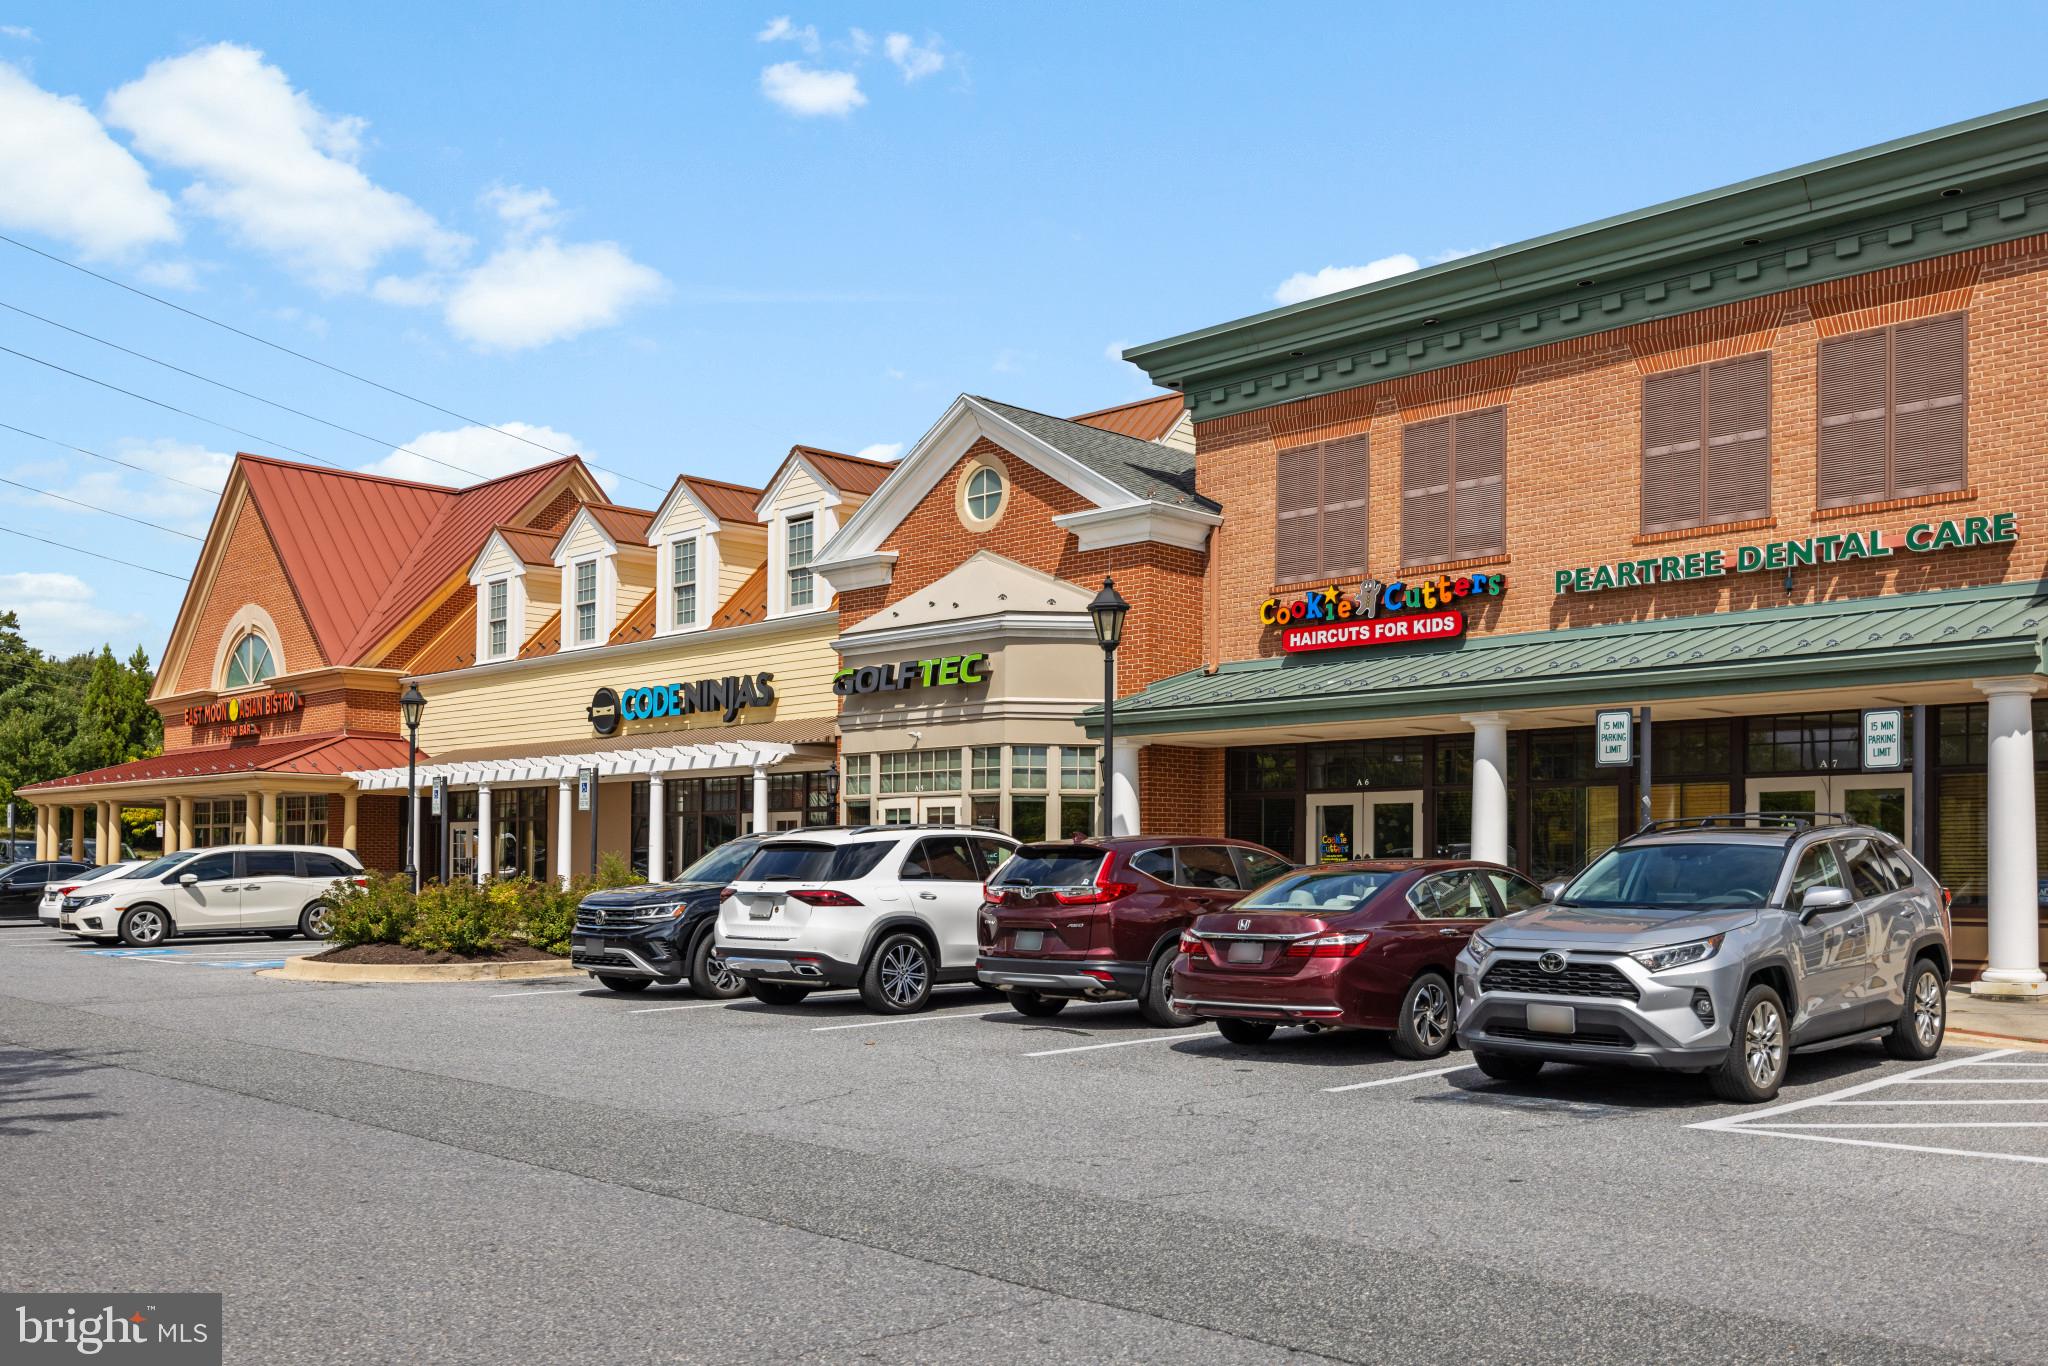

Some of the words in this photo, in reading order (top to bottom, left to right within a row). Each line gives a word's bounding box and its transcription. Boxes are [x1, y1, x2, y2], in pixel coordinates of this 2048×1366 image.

[1555, 550, 1725, 594] PEARTREE
[1736, 530, 1893, 573] DENTAL
[1905, 513, 2018, 552] CARE
[1384, 574, 1502, 611] Cutters
[1290, 626, 1370, 647] HAIRCUTS
[1375, 622, 1408, 638] FOR
[1413, 616, 1455, 634] KIDS
[832, 652, 987, 696] GOLFTEC
[184, 706, 203, 726] EAST
[205, 702, 227, 723] MOON
[240, 696, 263, 719] ASIAN
[265, 690, 295, 714] BISTRO
[240, 724, 251, 736] BAR
[1604, 722, 1610, 730] 15
[1613, 721, 1625, 730] MIN
[1871, 722, 1878, 731] 15
[1880, 721, 1894, 730] MIN
[1601, 733, 1627, 742] PARKING
[1868, 734, 1896, 744] PARKING
[1605, 745, 1622, 754] LIMIT
[1873, 747, 1891, 757] LIMIT
[1820, 760, 1828, 768] A
[1832, 760, 1838, 768] 7
